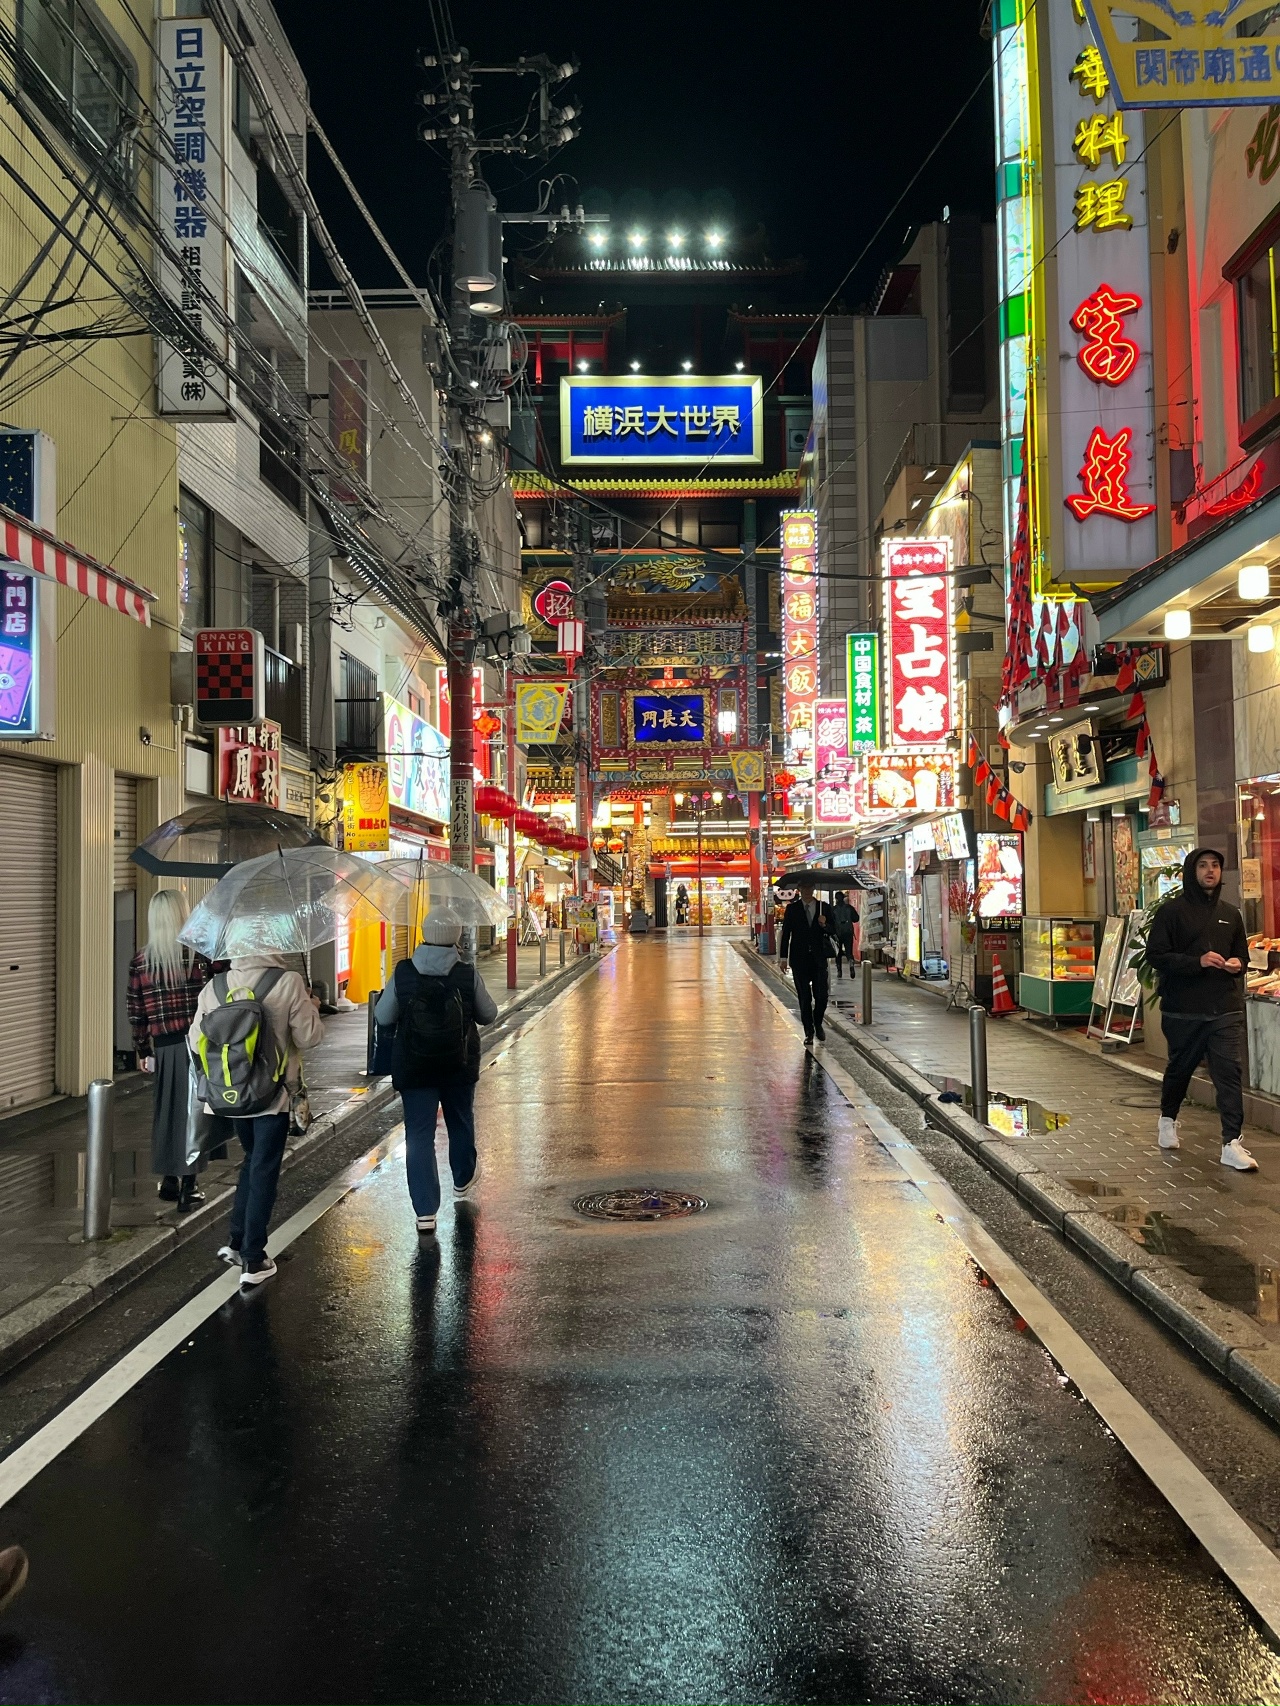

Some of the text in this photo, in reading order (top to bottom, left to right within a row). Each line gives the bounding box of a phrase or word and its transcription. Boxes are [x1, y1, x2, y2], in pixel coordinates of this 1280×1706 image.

[174, 28, 207, 239] 日立空調機器
[1071, 0, 1132, 232] 華料理
[583, 405, 741, 436] 横浜大世界
[200, 633, 245, 641] SNACK
[203, 641, 249, 652] KING
[854, 638, 873, 734] 中国食材・茶
[233, 748, 280, 804] 鳳林
[455, 786, 466, 811] BAR
